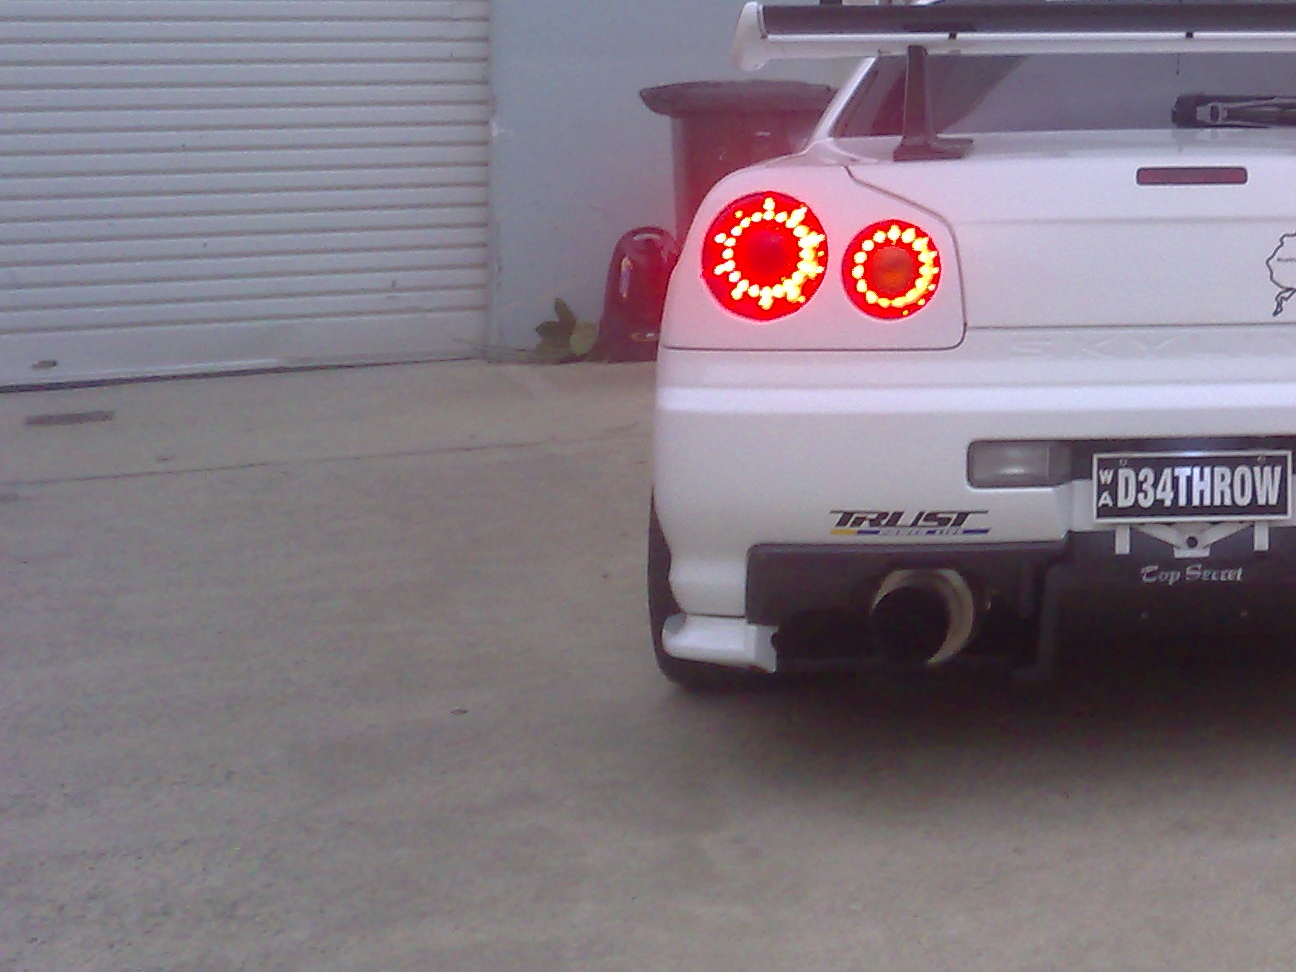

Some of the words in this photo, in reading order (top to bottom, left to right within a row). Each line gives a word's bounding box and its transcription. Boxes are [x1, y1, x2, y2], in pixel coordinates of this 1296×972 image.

[1117, 464, 1283, 509] D34THROW
[830, 510, 989, 528] TRUST
[1140, 564, 1182, 586] Top
[1185, 563, 1243, 582] Secret
